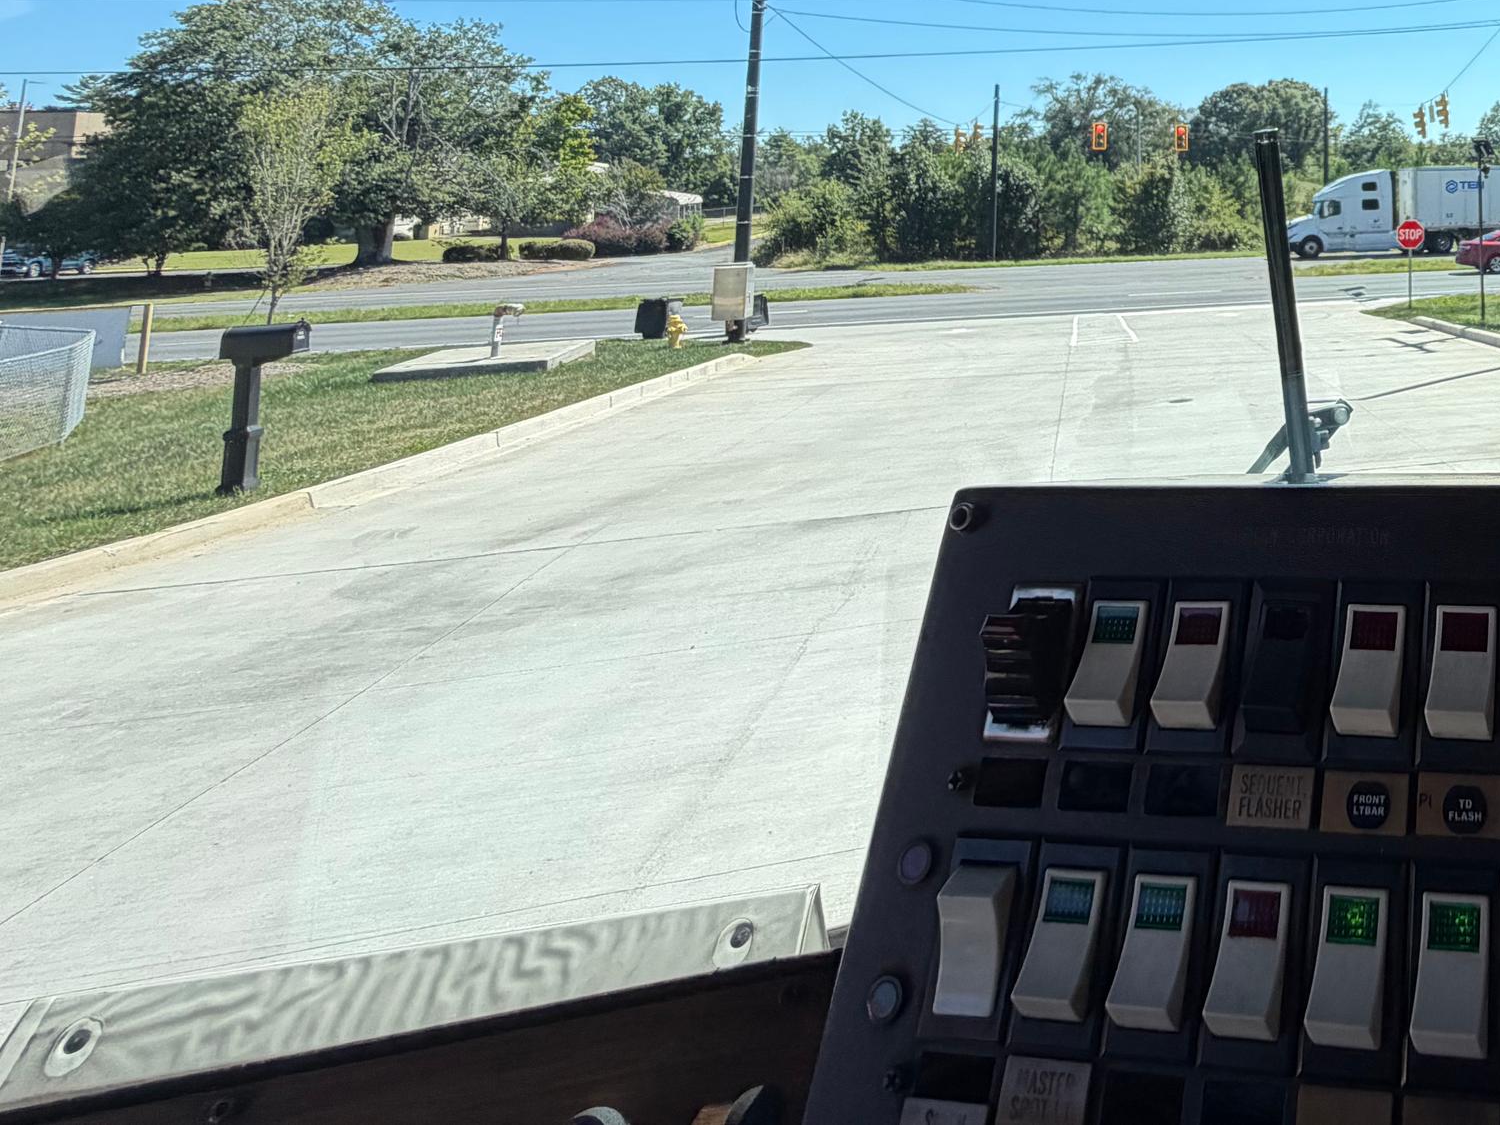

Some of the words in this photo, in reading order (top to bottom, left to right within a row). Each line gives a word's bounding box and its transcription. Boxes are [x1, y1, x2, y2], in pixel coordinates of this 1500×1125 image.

[1399, 229, 1423, 241] STOP
[1353, 793, 1386, 805] FRONT
[1239, 796, 1302, 820] FLASHER
[1448, 810, 1483, 823] FLASH
